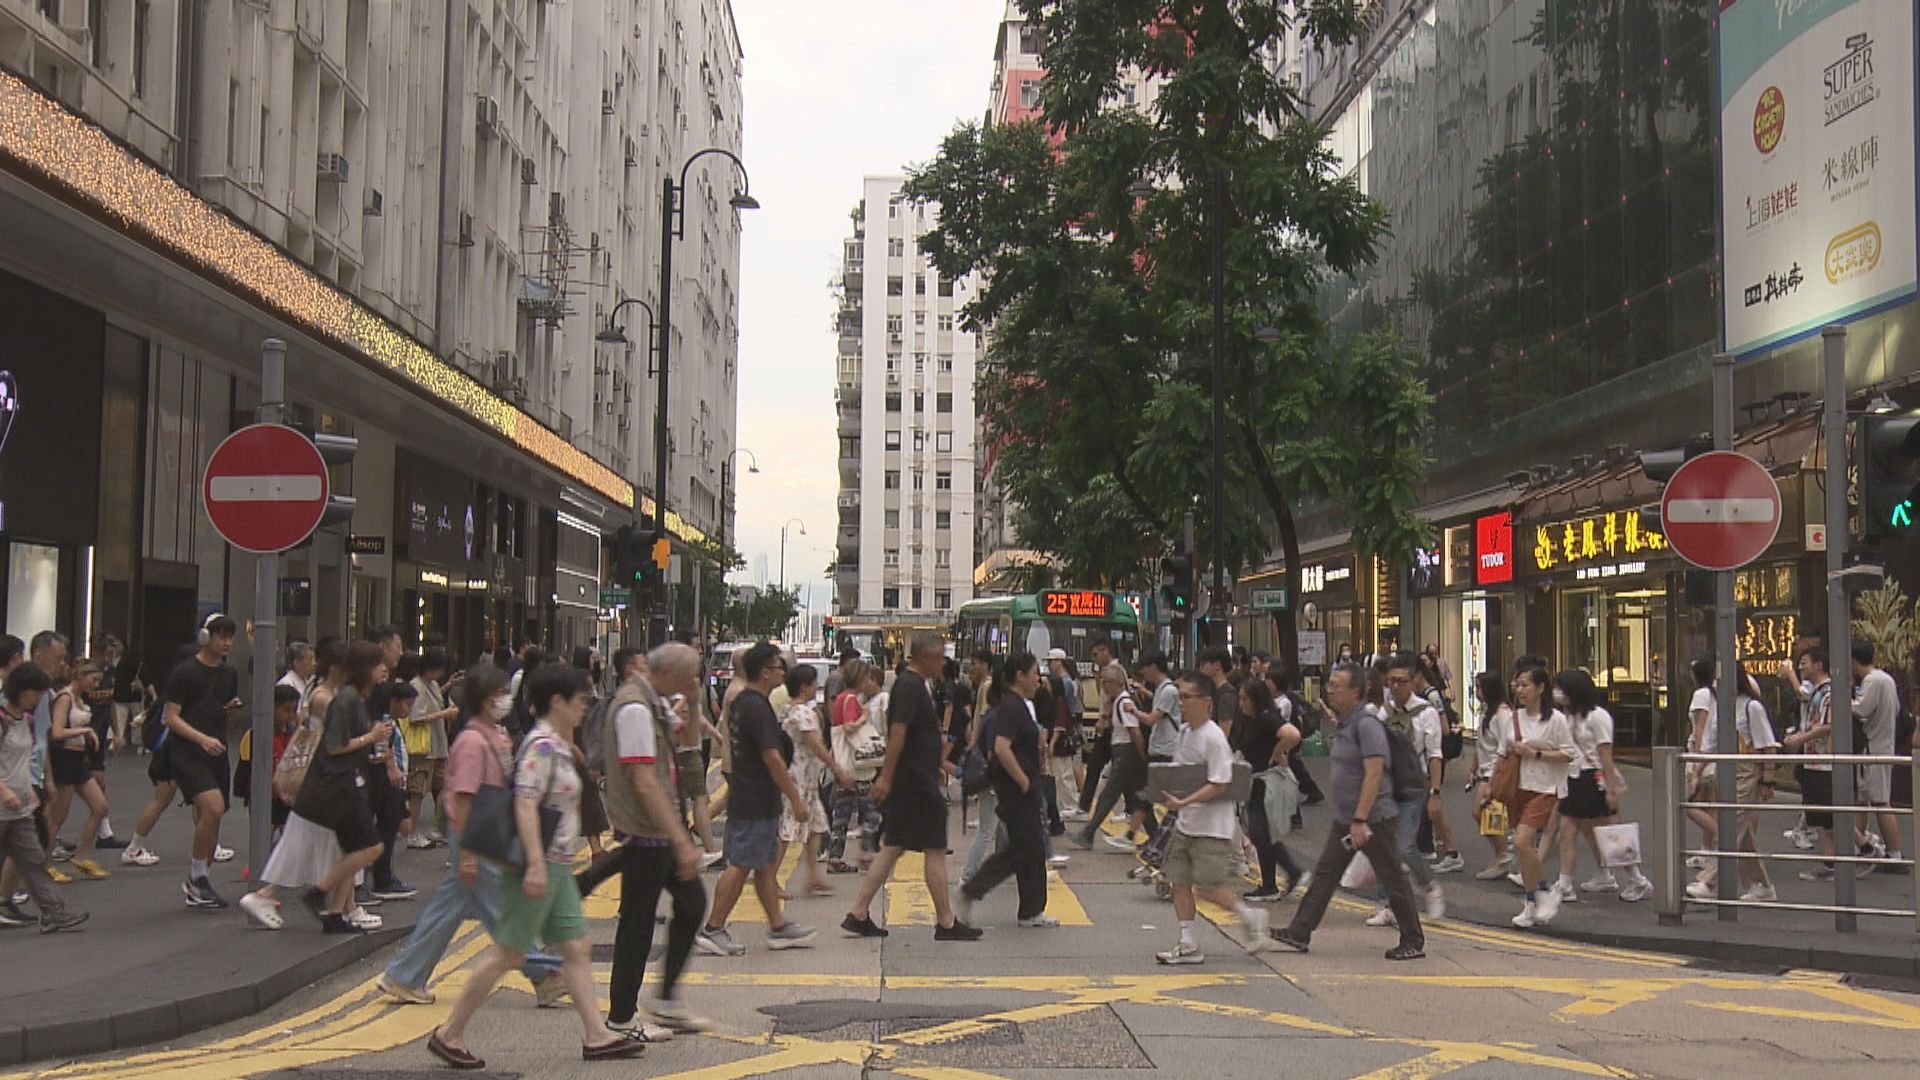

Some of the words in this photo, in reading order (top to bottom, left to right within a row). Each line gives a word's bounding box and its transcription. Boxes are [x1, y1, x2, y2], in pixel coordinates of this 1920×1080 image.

[1824, 47, 1874, 101] SUPER
[1824, 82, 1874, 121] SANDWICHES
[1822, 134, 1879, 192] 米線陣
[1745, 181, 1799, 231] 上海姥姥
[1481, 552, 1504, 569] TUDOR
[1047, 593, 1068, 614] 25
